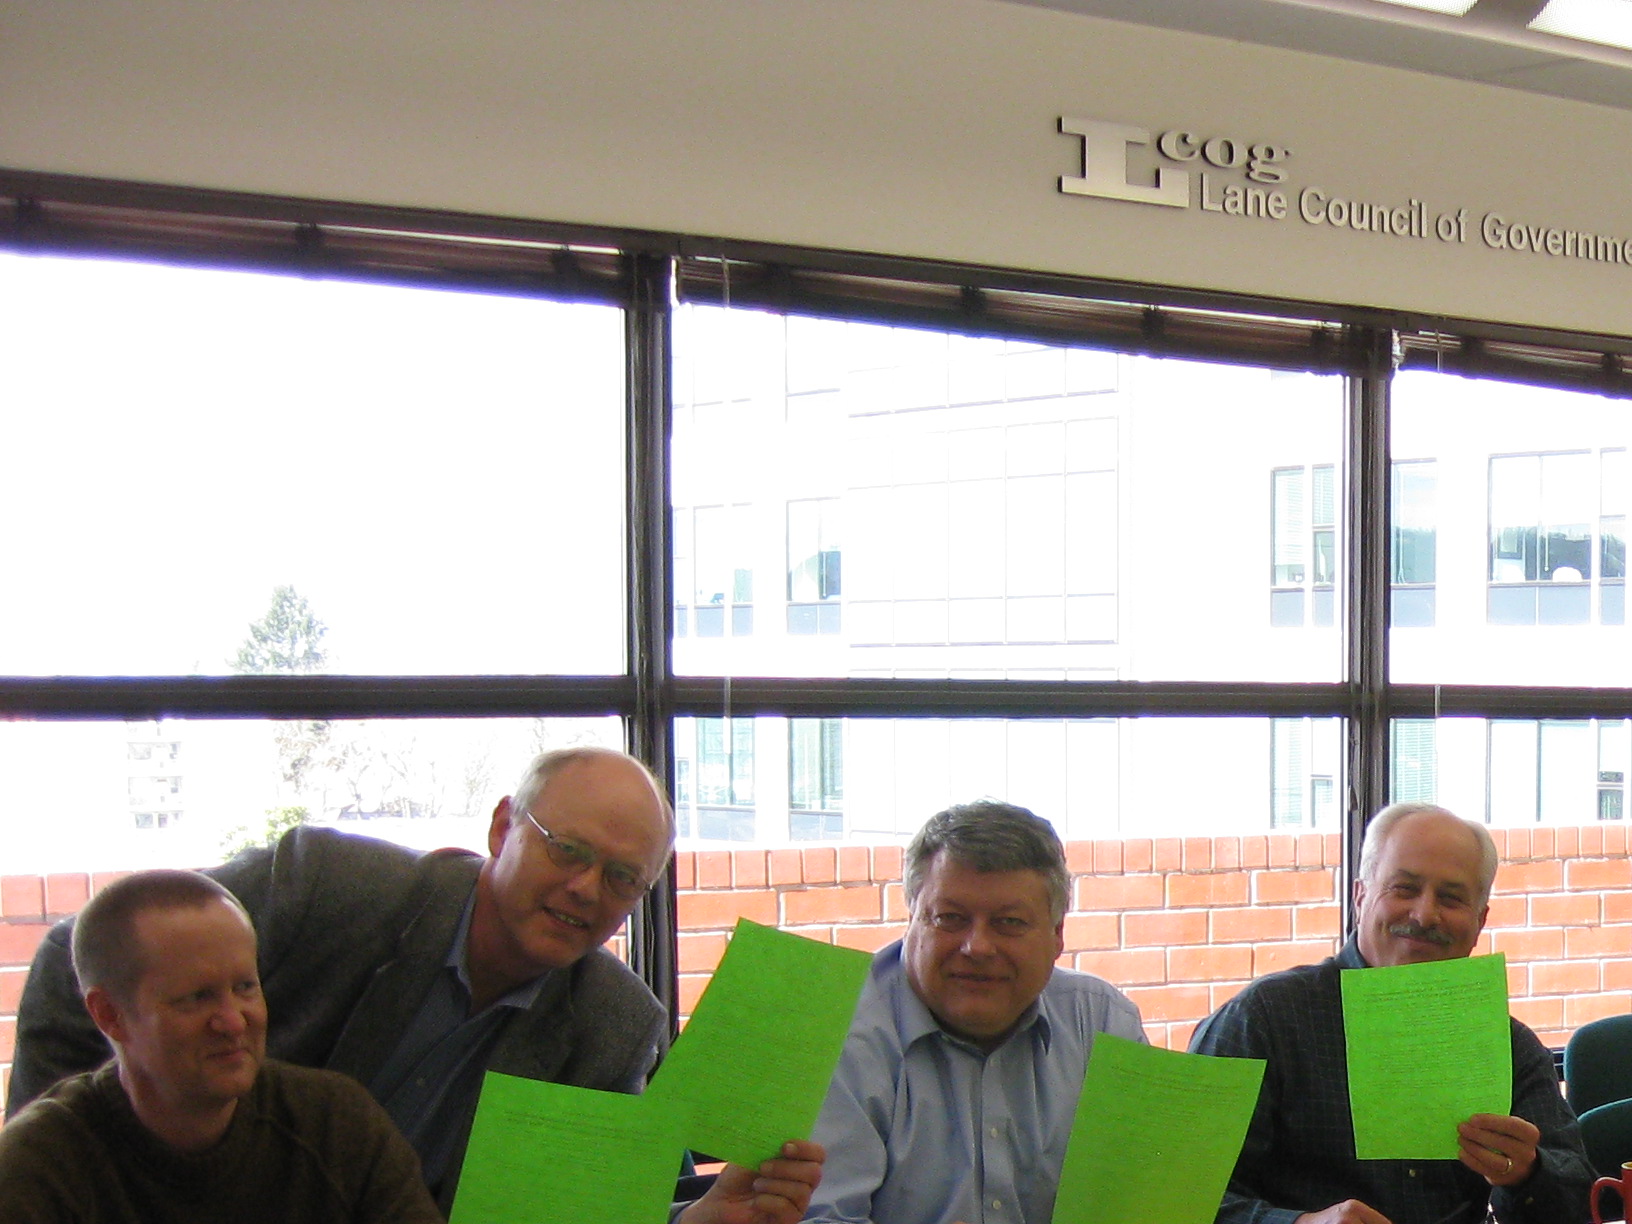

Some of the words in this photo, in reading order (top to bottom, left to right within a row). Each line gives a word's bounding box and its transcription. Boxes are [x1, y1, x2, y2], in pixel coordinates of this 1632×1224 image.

[1200, 172, 1288, 220] Lane
[1299, 185, 1429, 238] Council
[1435, 208, 1468, 242] of
